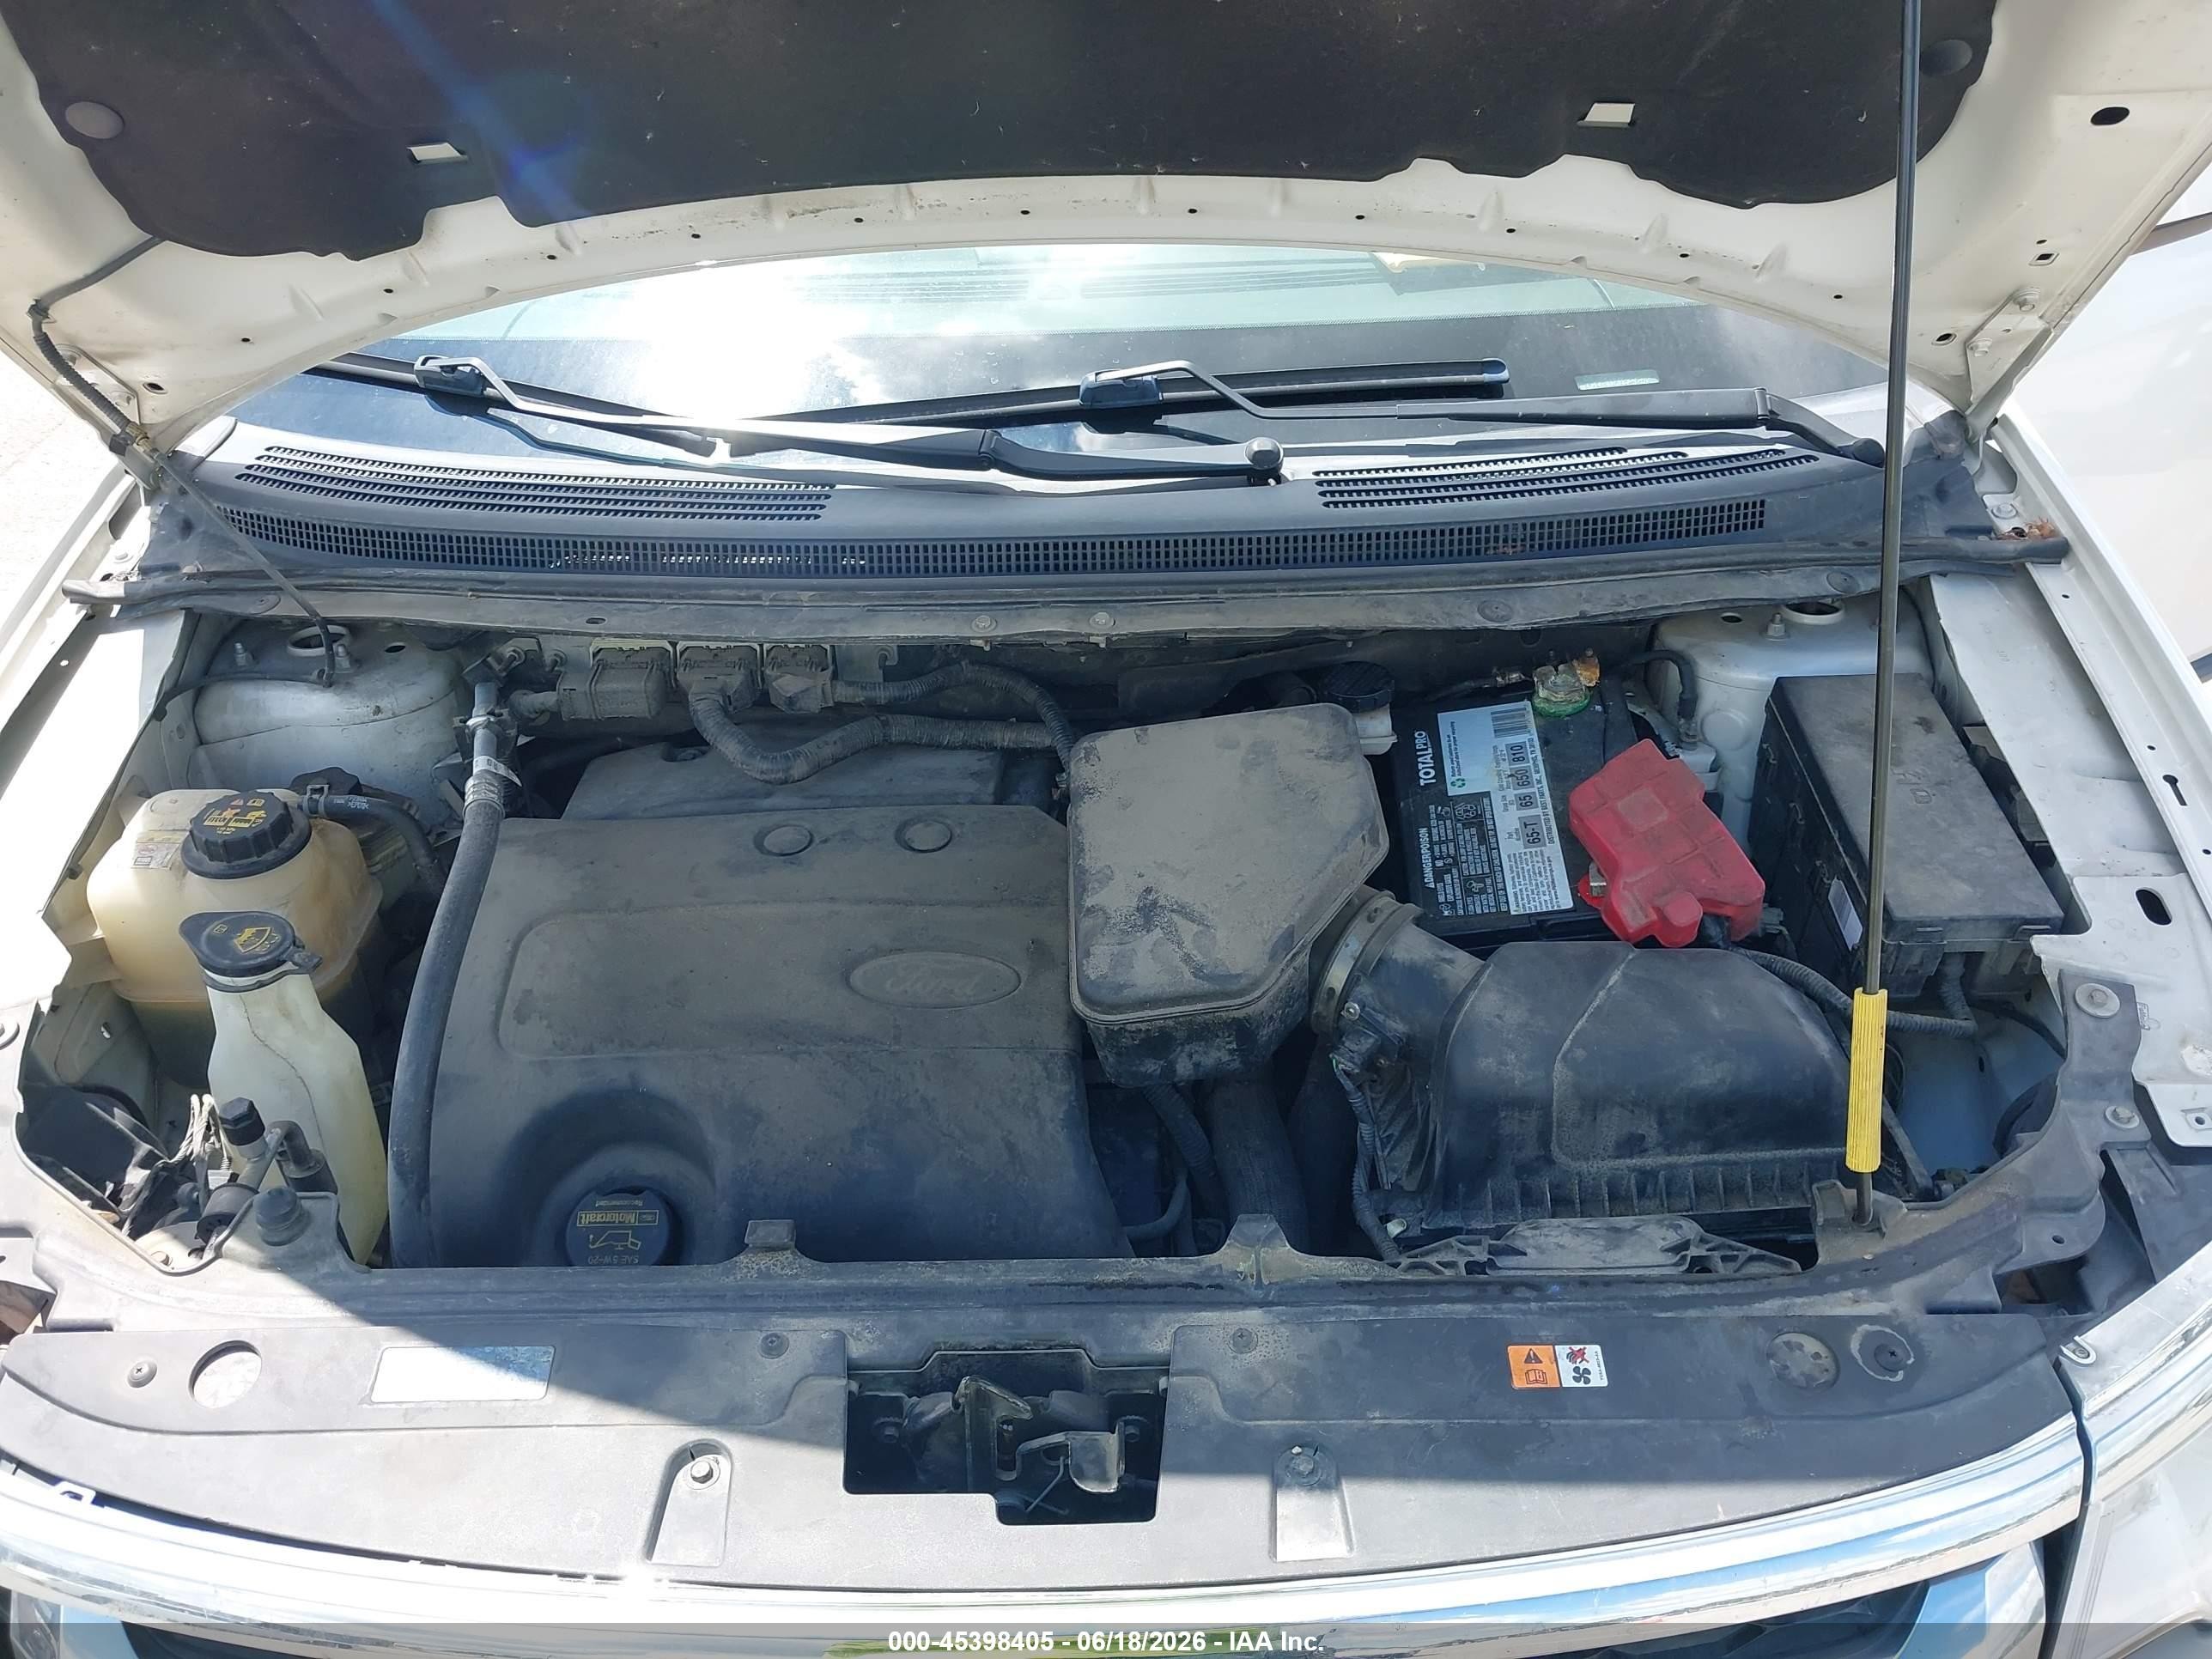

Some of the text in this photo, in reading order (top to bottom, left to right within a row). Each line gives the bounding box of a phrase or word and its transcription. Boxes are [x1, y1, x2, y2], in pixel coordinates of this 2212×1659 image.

[1510, 744, 1525, 762] 810
[1514, 768, 1530, 787] 650
[1517, 794, 1534, 807] 65
[1522, 820, 1541, 844] 65-T
[579, 1212, 635, 1224] Motorcraft
[587, 1255, 639, 1263] SAE 5W-20
